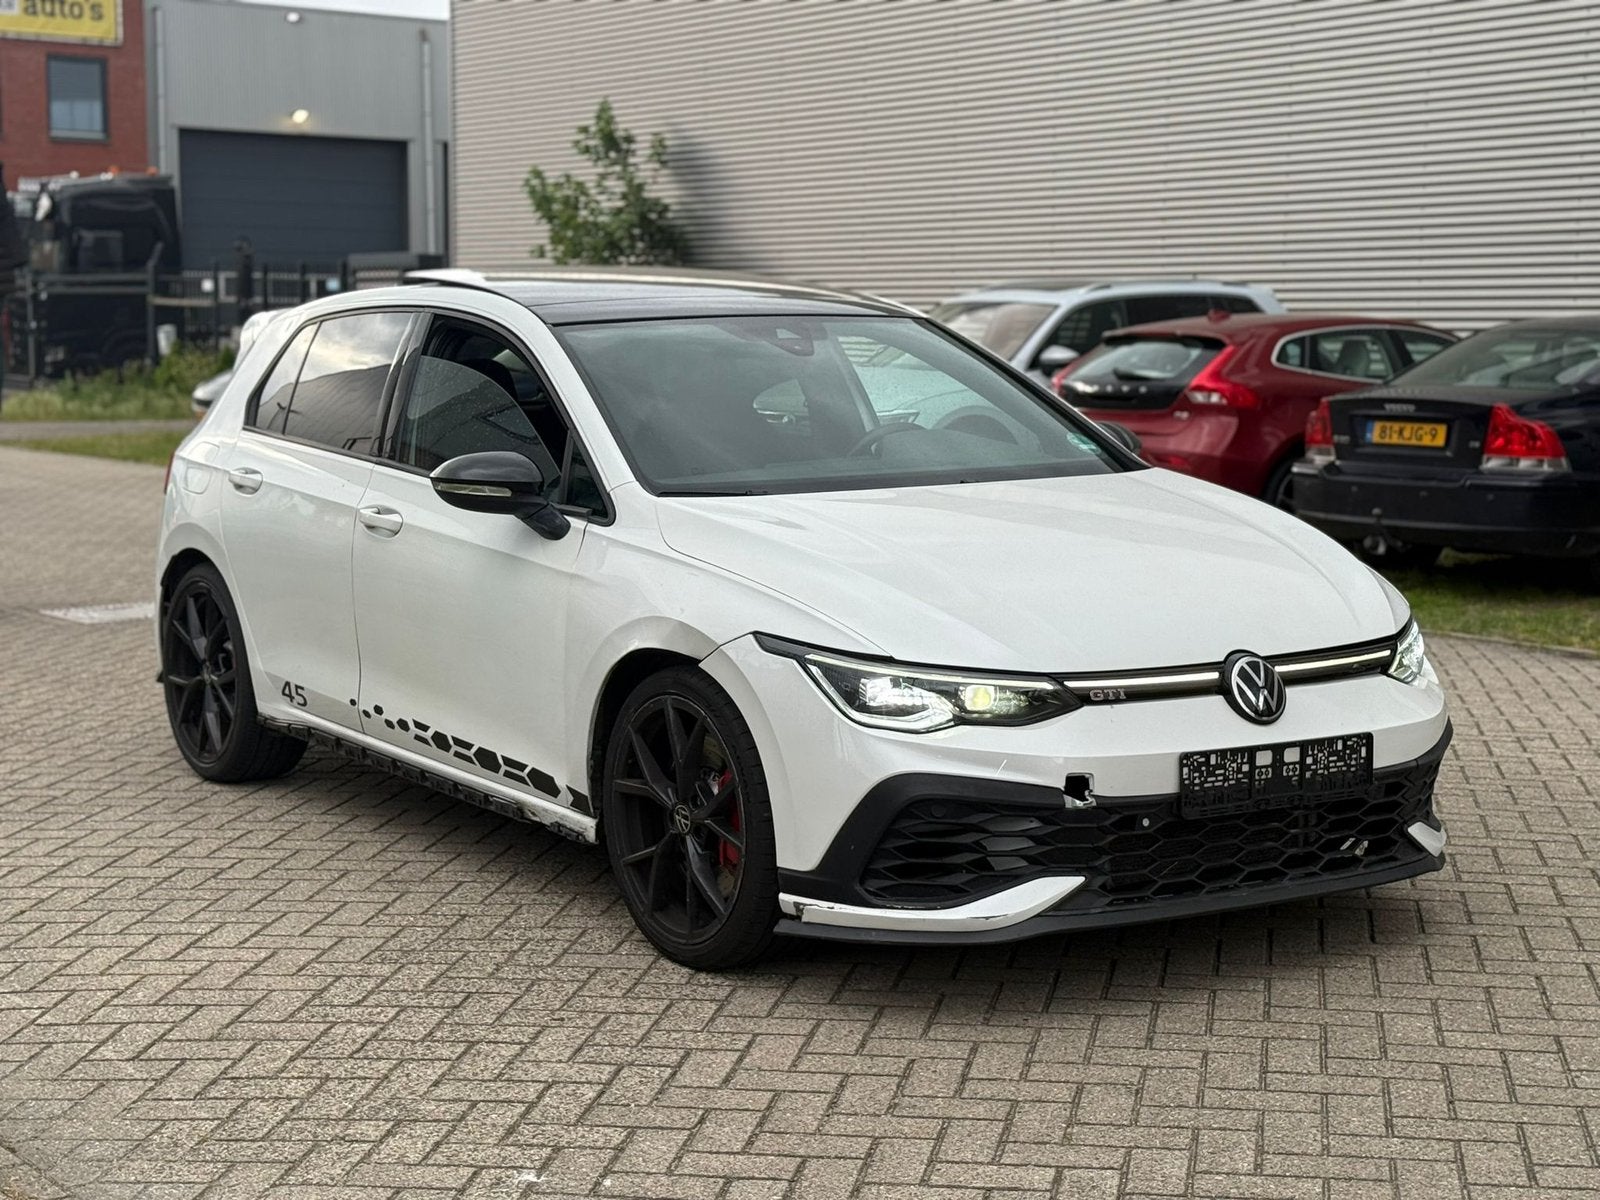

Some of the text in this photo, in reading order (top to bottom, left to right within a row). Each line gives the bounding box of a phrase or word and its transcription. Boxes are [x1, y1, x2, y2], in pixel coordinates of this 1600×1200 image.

[23, 0, 103, 21] autos
[1379, 424, 1438, 443] 81-KJG-9
[281, 680, 308, 707] 45
[1089, 688, 1127, 701] GTI
